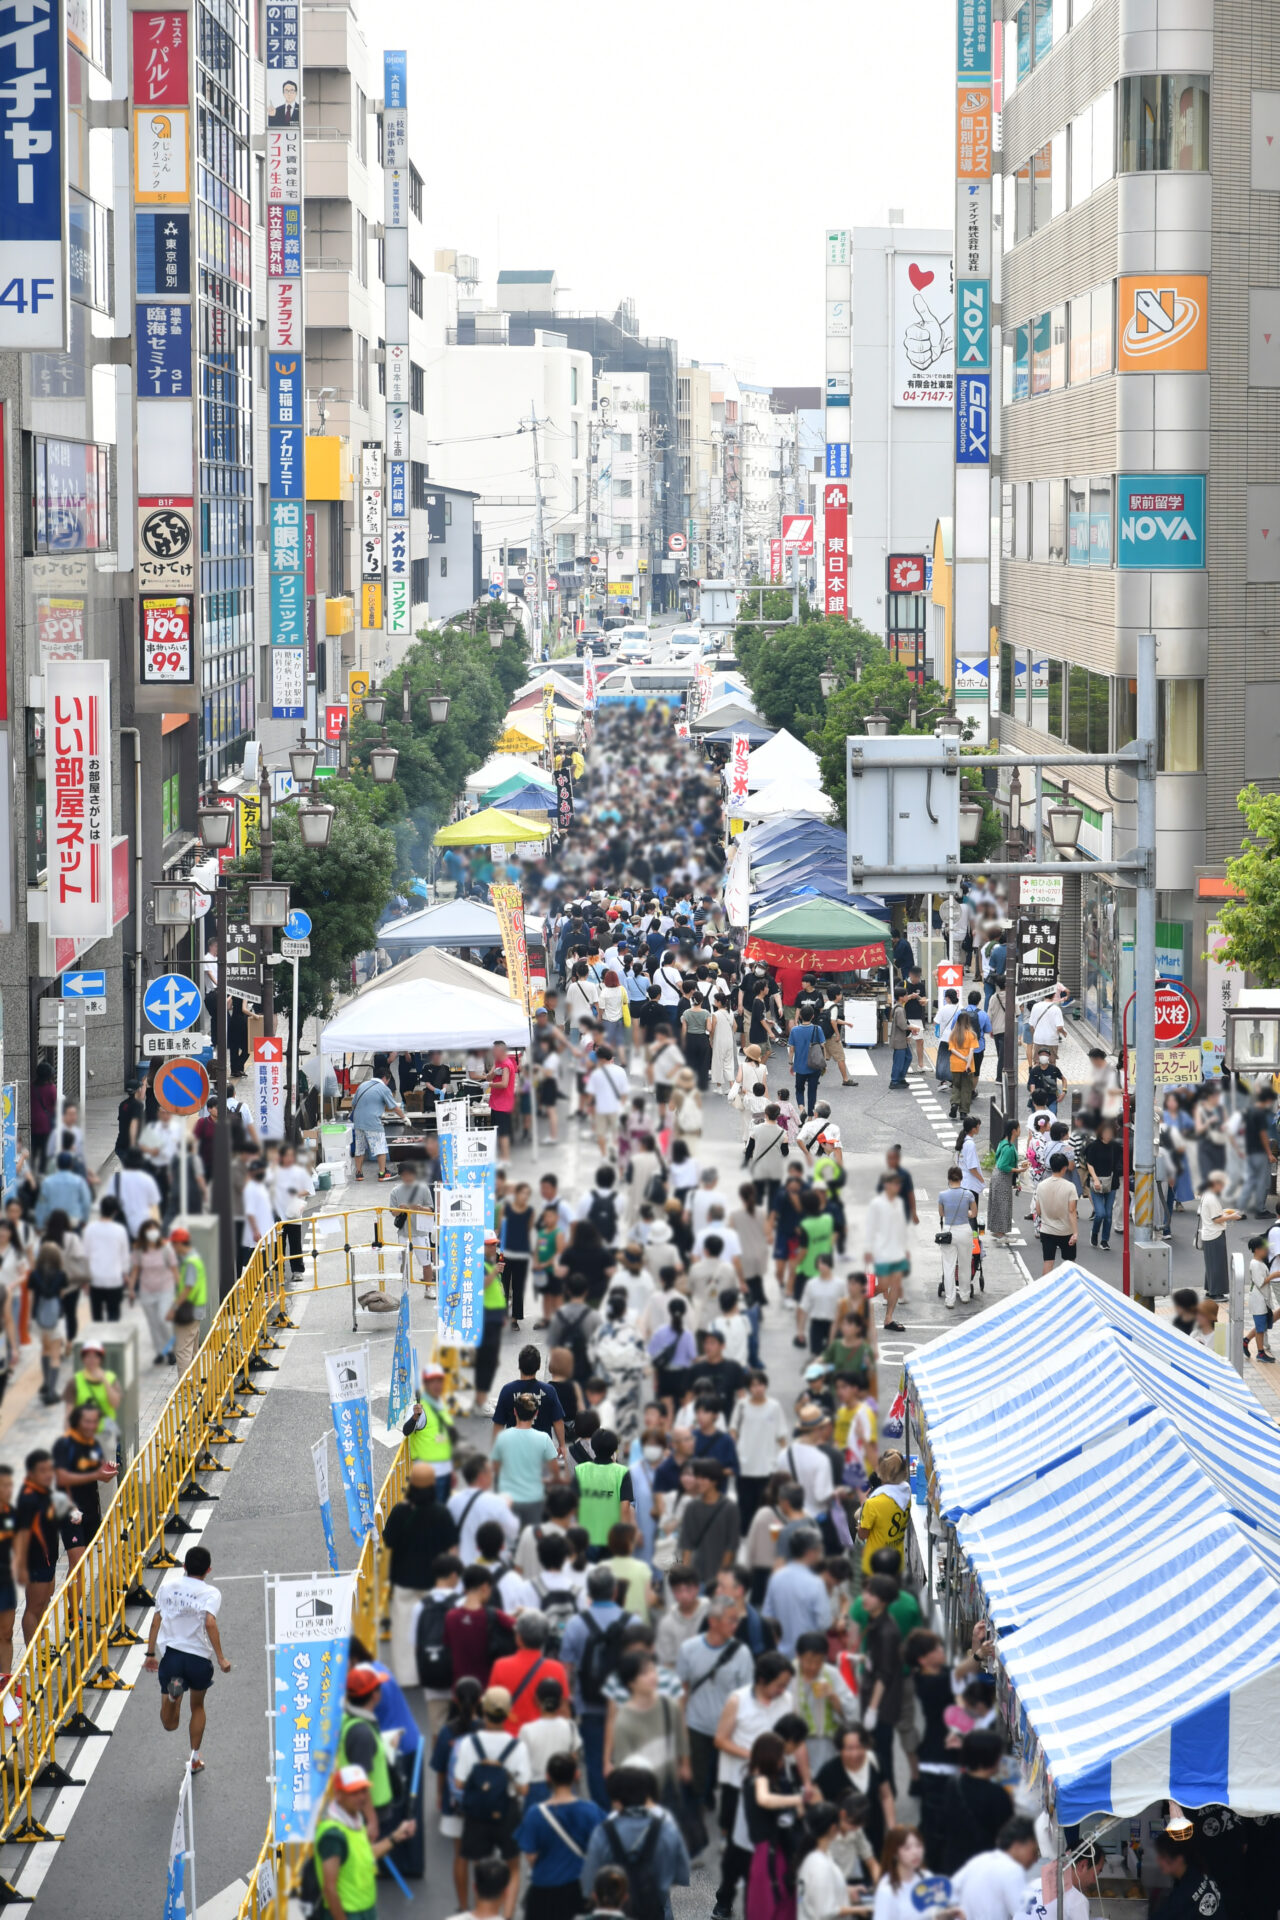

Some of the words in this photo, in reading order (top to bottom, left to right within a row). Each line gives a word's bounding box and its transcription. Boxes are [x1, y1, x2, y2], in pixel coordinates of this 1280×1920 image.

[172, 17, 182, 48] エステ
[268, 7, 281, 68] のトライ
[284, 6, 297, 68] 個別教室
[391, 74, 400, 107] 大同生命
[152, 141, 161, 189] クリニック
[162, 141, 174, 173] じぶん
[387, 122, 396, 166] 法律事務所
[960, 117, 973, 172] 個別指導
[975, 117, 988, 172] ユリウス
[269, 133, 282, 199] フコク生命
[269, 207, 283, 275] 共立美容外科
[968, 202, 980, 251] テイケイ株式会社
[165, 239, 178, 287] 東京個別
[968, 252, 980, 272] 柏支社
[0, 278, 55, 314] 4F
[276, 284, 293, 346] アデランス
[170, 308, 182, 335] 進学塾
[962, 288, 984, 361] NOVA
[146, 307, 168, 395] 臨海セミナー
[278, 379, 293, 422] 早稲田
[393, 364, 402, 401] 日本生命
[959, 380, 968, 416] Mounting
[393, 420, 403, 457] ソニー生命
[959, 417, 968, 454] Solutions
[969, 380, 987, 457] GCX
[280, 430, 293, 496] アカデミー
[393, 464, 404, 513] 水戸証券
[1130, 495, 1182, 510] 駅前留学
[273, 503, 299, 570] 柏眼科
[1121, 516, 1197, 544] NOVA
[140, 562, 193, 577] てけてけ
[392, 531, 406, 573] メガネ
[146, 609, 175, 619] 生ビール
[279, 576, 297, 632] クリニック
[392, 582, 406, 631] コンタクト
[146, 642, 188, 655] 串物いろいろ
[957, 678, 988, 688] 柏ホーム
[282, 707, 296, 717] 1F
[732, 738, 749, 796] かき氷
[55, 695, 85, 903] いい部屋ネット
[89, 759, 101, 841] お部屋さがしは
[556, 774, 570, 826] からあげ
[1022, 935, 1057, 945] 展示場
[1028, 925, 1051, 935] 住宅
[1022, 967, 1055, 977] 柏駅西口
[149, 1037, 198, 1051] 自転車を除く
[271, 1065, 280, 1107] 柏まつり
